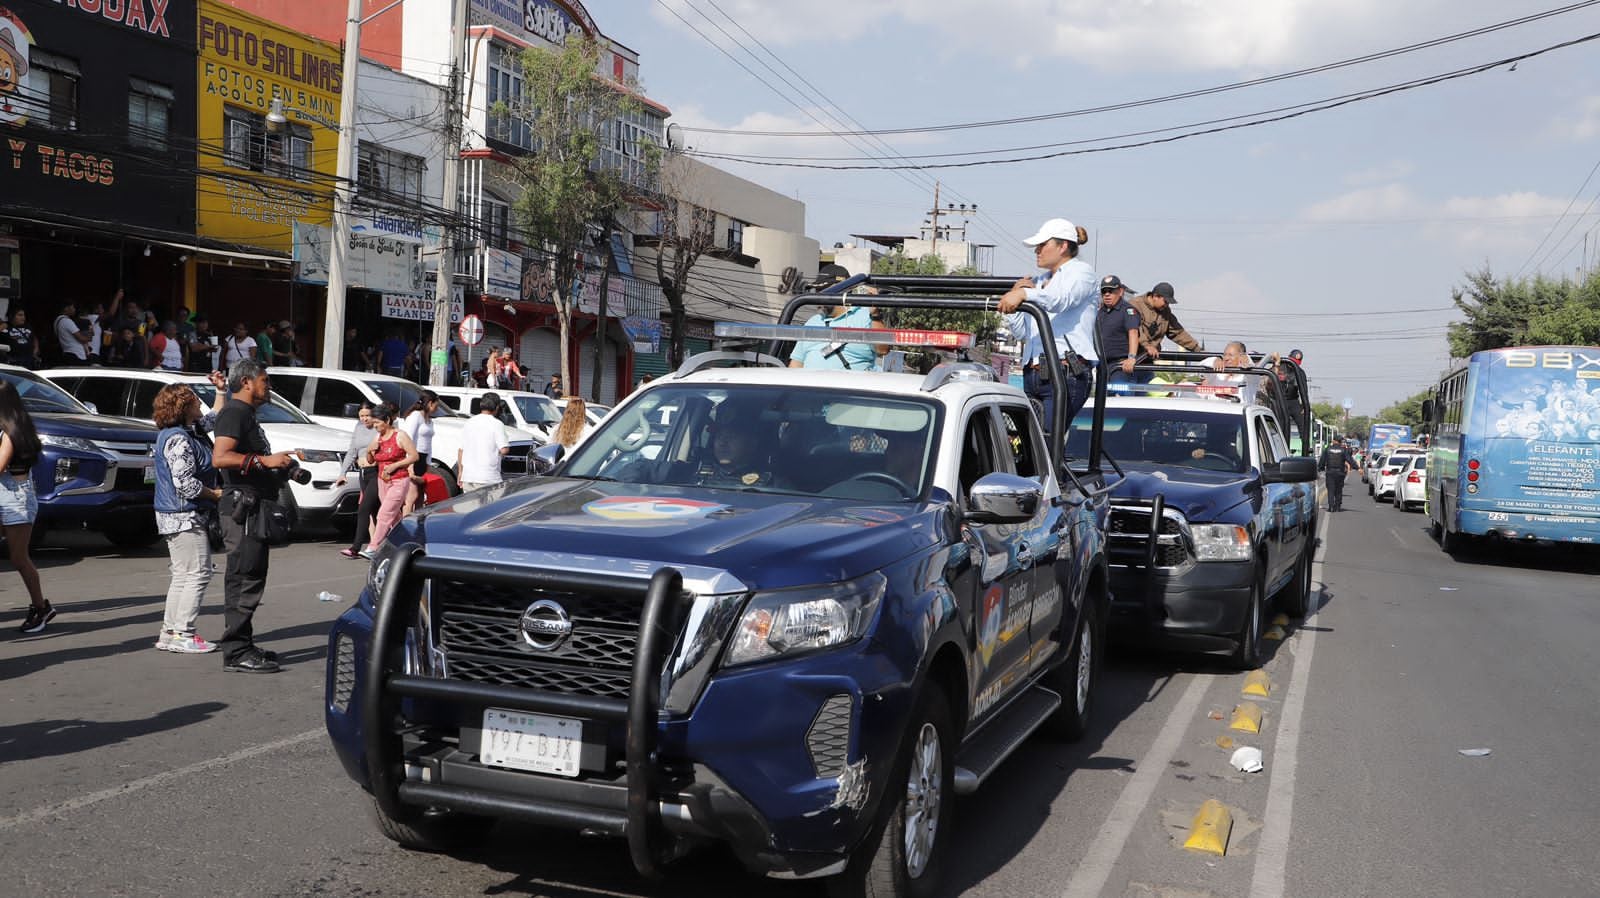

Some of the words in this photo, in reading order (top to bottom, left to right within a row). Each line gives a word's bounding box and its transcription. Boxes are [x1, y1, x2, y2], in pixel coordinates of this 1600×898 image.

[200, 15, 258, 66] FOTO
[262, 39, 343, 94] SALINAS
[205, 62, 265, 94] FOTOS
[271, 83, 293, 103] EN
[297, 91, 307, 106] 5
[8, 138, 26, 169] Y
[38, 144, 114, 186] TACOS
[386, 296, 460, 313] LAVANDIA
[389, 307, 458, 322] PLANCHO
[1534, 445, 1593, 456] ELEFANTE
[522, 619, 567, 633] NISSAN
